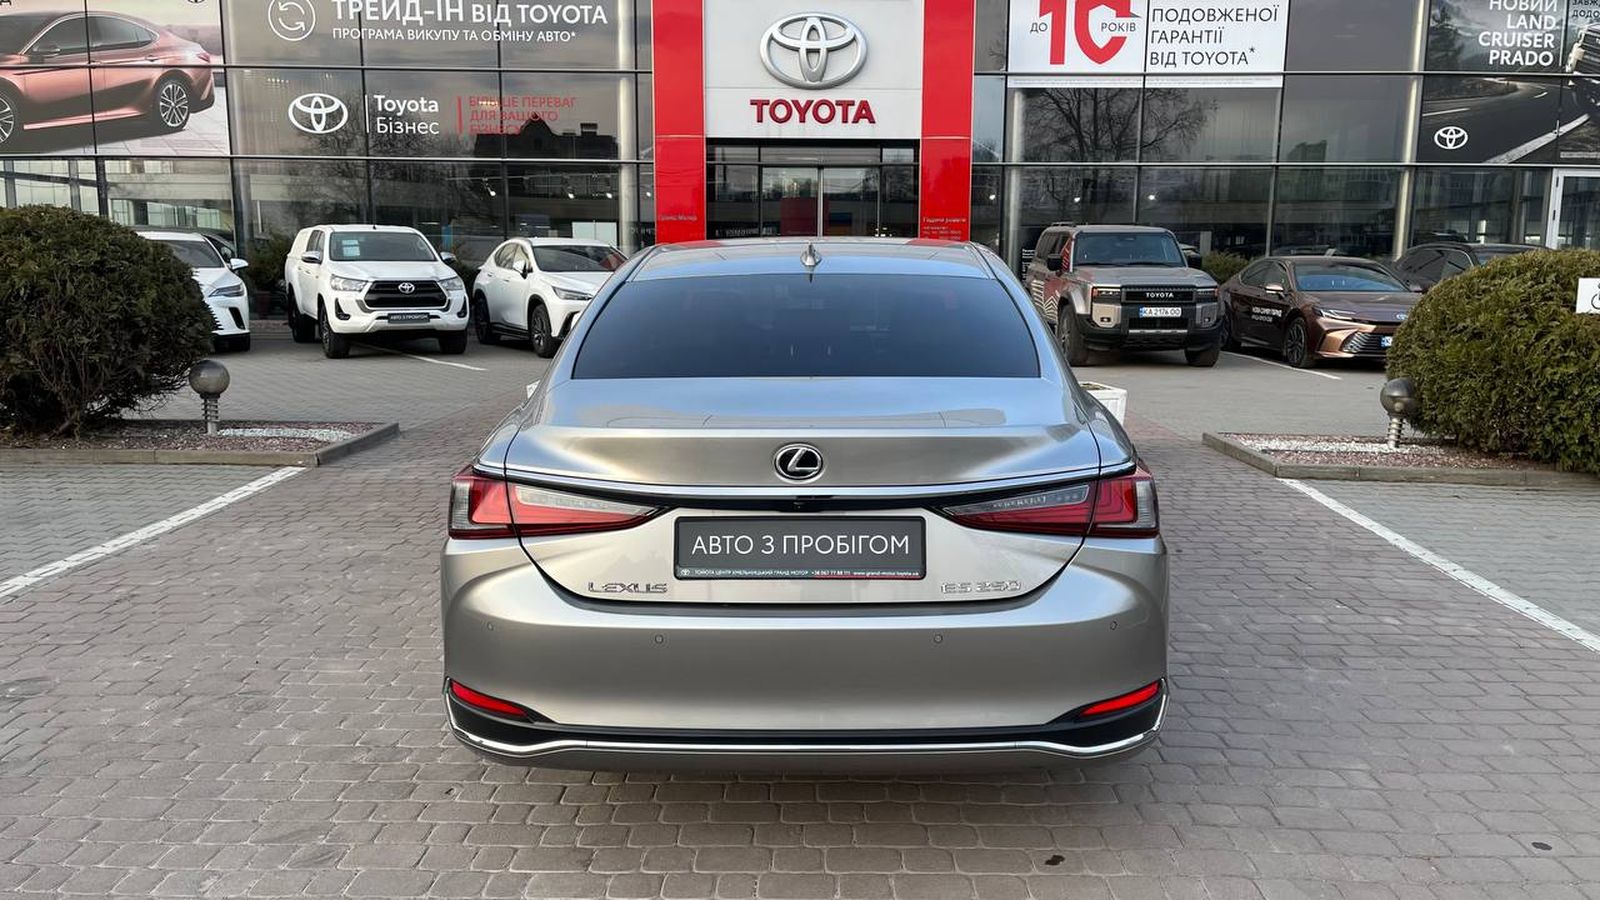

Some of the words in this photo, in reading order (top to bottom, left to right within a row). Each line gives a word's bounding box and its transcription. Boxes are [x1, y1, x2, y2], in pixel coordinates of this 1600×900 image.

[471, 4, 512, 27] ВІД
[516, 4, 609, 24] TOYOTA
[1152, 4, 1280, 25] ПОДОВЖЕНОЇ
[1506, 14, 1557, 30] LAND
[332, 28, 405, 40] ПРОГРАМА
[407, 29, 461, 41] ВИКУПУ
[462, 30, 479, 41] ТА
[481, 30, 534, 42] ОБМІНУ
[1030, 22, 1048, 34] ДО
[1101, 22, 1137, 33] РОКІВ
[1151, 26, 1225, 44] ГАРАНТІЇ
[1478, 31, 1556, 49] CRUISER
[1150, 52, 1177, 68] ВІД
[1488, 50, 1554, 67] PRADO
[373, 94, 439, 116] Toyota
[521, 96, 577, 108] ПЕРЕВАГ
[470, 110, 497, 122] ДЛЯ
[750, 98, 876, 124] TOYOTA
[376, 117, 440, 135] Бізнес
[692, 535, 754, 555] АВТО
[761, 535, 775, 555] З
[783, 535, 910, 555] ПРОБІГОМ
[587, 581, 668, 594] LEXUS
[941, 582, 972, 594] ES
[976, 581, 1020, 593] 250
